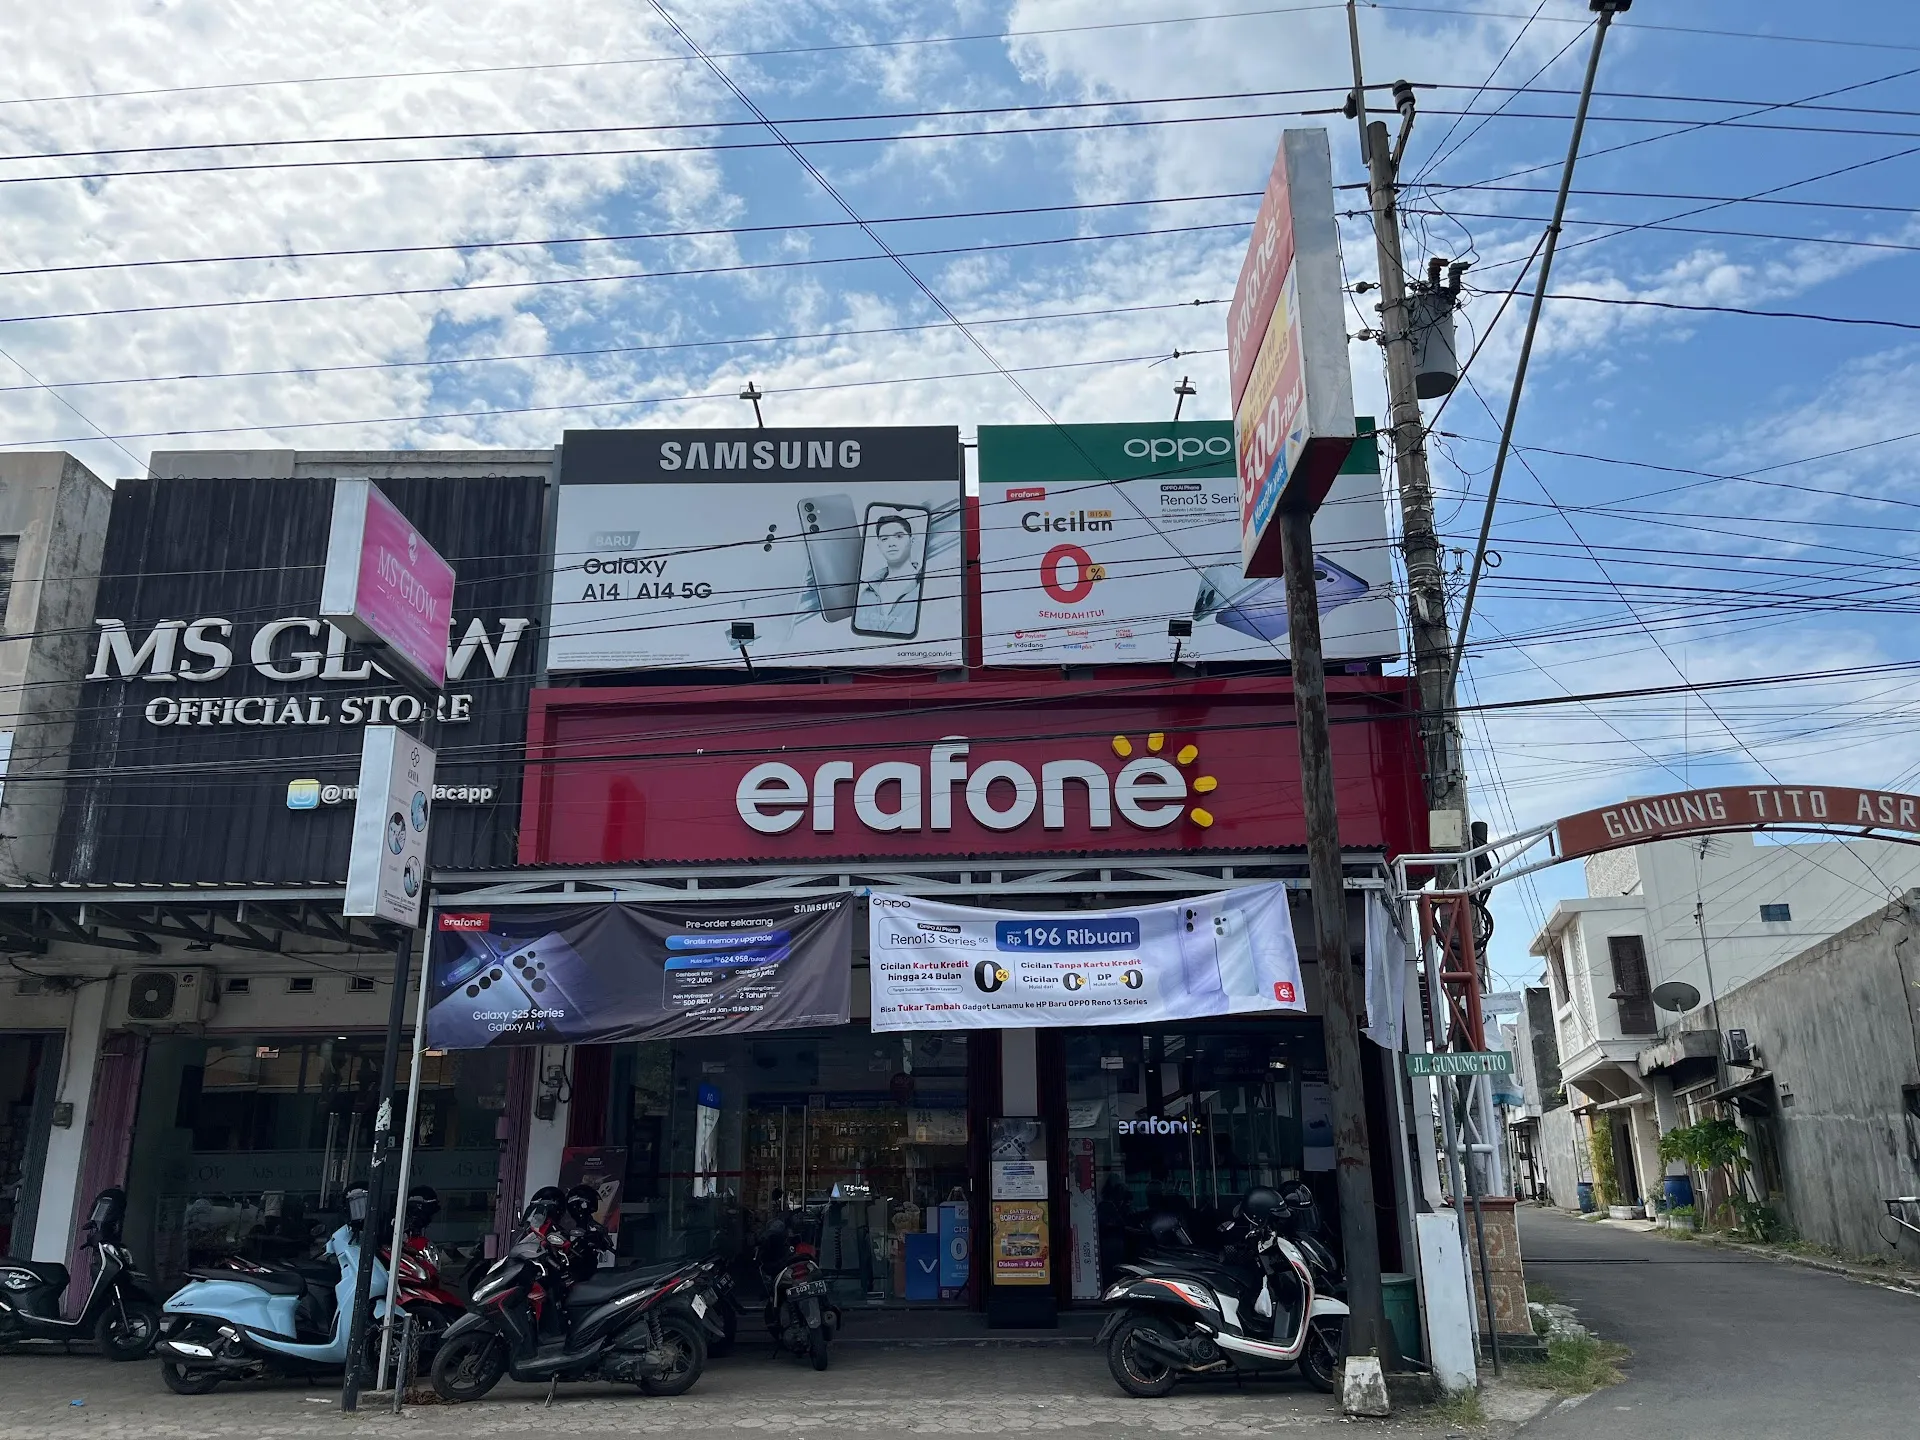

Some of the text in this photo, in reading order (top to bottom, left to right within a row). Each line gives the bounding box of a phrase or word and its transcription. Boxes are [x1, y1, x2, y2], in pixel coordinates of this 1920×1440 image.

[1281, 377, 1299, 437] ribu
[660, 439, 861, 471] SAMSUNG
[1123, 437, 1231, 462] oppo
[1160, 494, 1208, 506] Reno13
[1021, 510, 1113, 533] Cicilan
[596, 535, 631, 547] BARU
[584, 557, 667, 578] Galaxy
[377, 545, 398, 588] MS
[400, 567, 437, 624] GLOW
[582, 582, 712, 600] A14 A14 5G
[1039, 609, 1105, 620] SEMUDAH ITU!
[85, 616, 530, 683] MS GLW
[144, 695, 330, 727] OFFICIAL
[735, 735, 1188, 833] erafone
[1602, 792, 1726, 839] GUNUNG
[1748, 790, 1827, 818] TITO
[794, 901, 841, 914] SAMSUNG
[443, 917, 482, 927] erafone
[685, 917, 773, 929] Pre-order sekarang
[707, 937, 739, 945] memory
[890, 932, 936, 945] Reno13
[938, 935, 977, 947] Series
[1006, 935, 1021, 946] Rp
[1024, 928, 1061, 946] 196
[881, 963, 911, 971] Cicilan
[941, 960, 969, 969] Kredit
[1054, 962, 1082, 970] Tanpa
[1112, 959, 1142, 967] Kredit
[888, 973, 920, 982] hingga
[936, 972, 962, 980] Bulan
[1022, 975, 1059, 983] Cicilan
[1097, 973, 1112, 981] DP
[898, 1004, 924, 1012] Tukar
[925, 1003, 960, 1011] Tambah
[991, 1002, 1024, 1010] Lamamu
[1048, 1000, 1067, 1008] Baru
[473, 1008, 564, 1022] Galaxy S25 Series
[488, 1021, 535, 1033] Galaxy AI
[1414, 1054, 1506, 1073] JL. GUNUNG TITO
[1118, 1116, 1196, 1135] erafone
